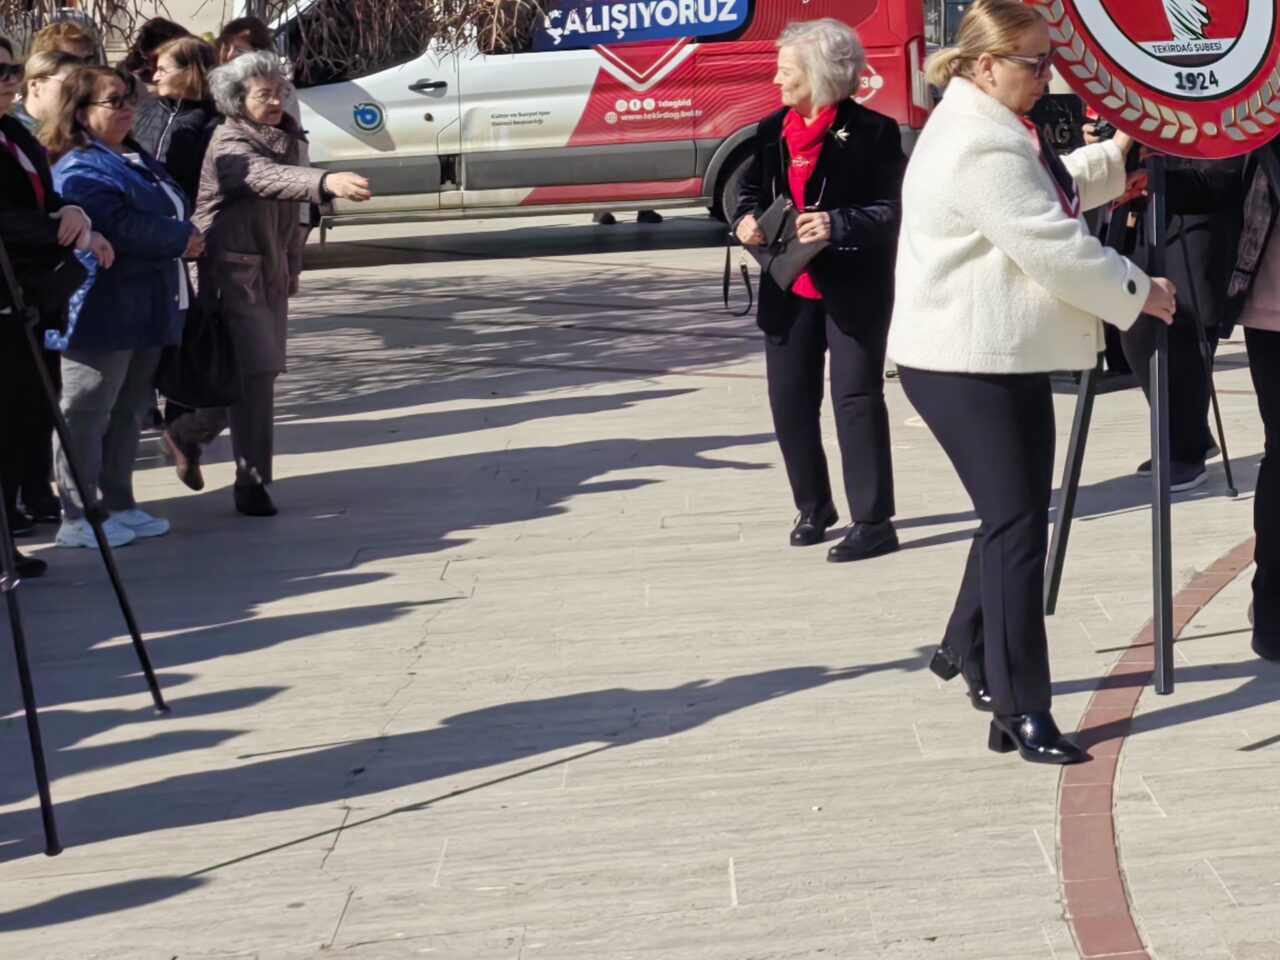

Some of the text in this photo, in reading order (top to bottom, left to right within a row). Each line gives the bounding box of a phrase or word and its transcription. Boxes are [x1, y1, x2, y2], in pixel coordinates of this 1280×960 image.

[1152, 40, 1222, 54] TEKİRDAĞ ŞUBESİ
[1174, 70, 1220, 91] 1924
